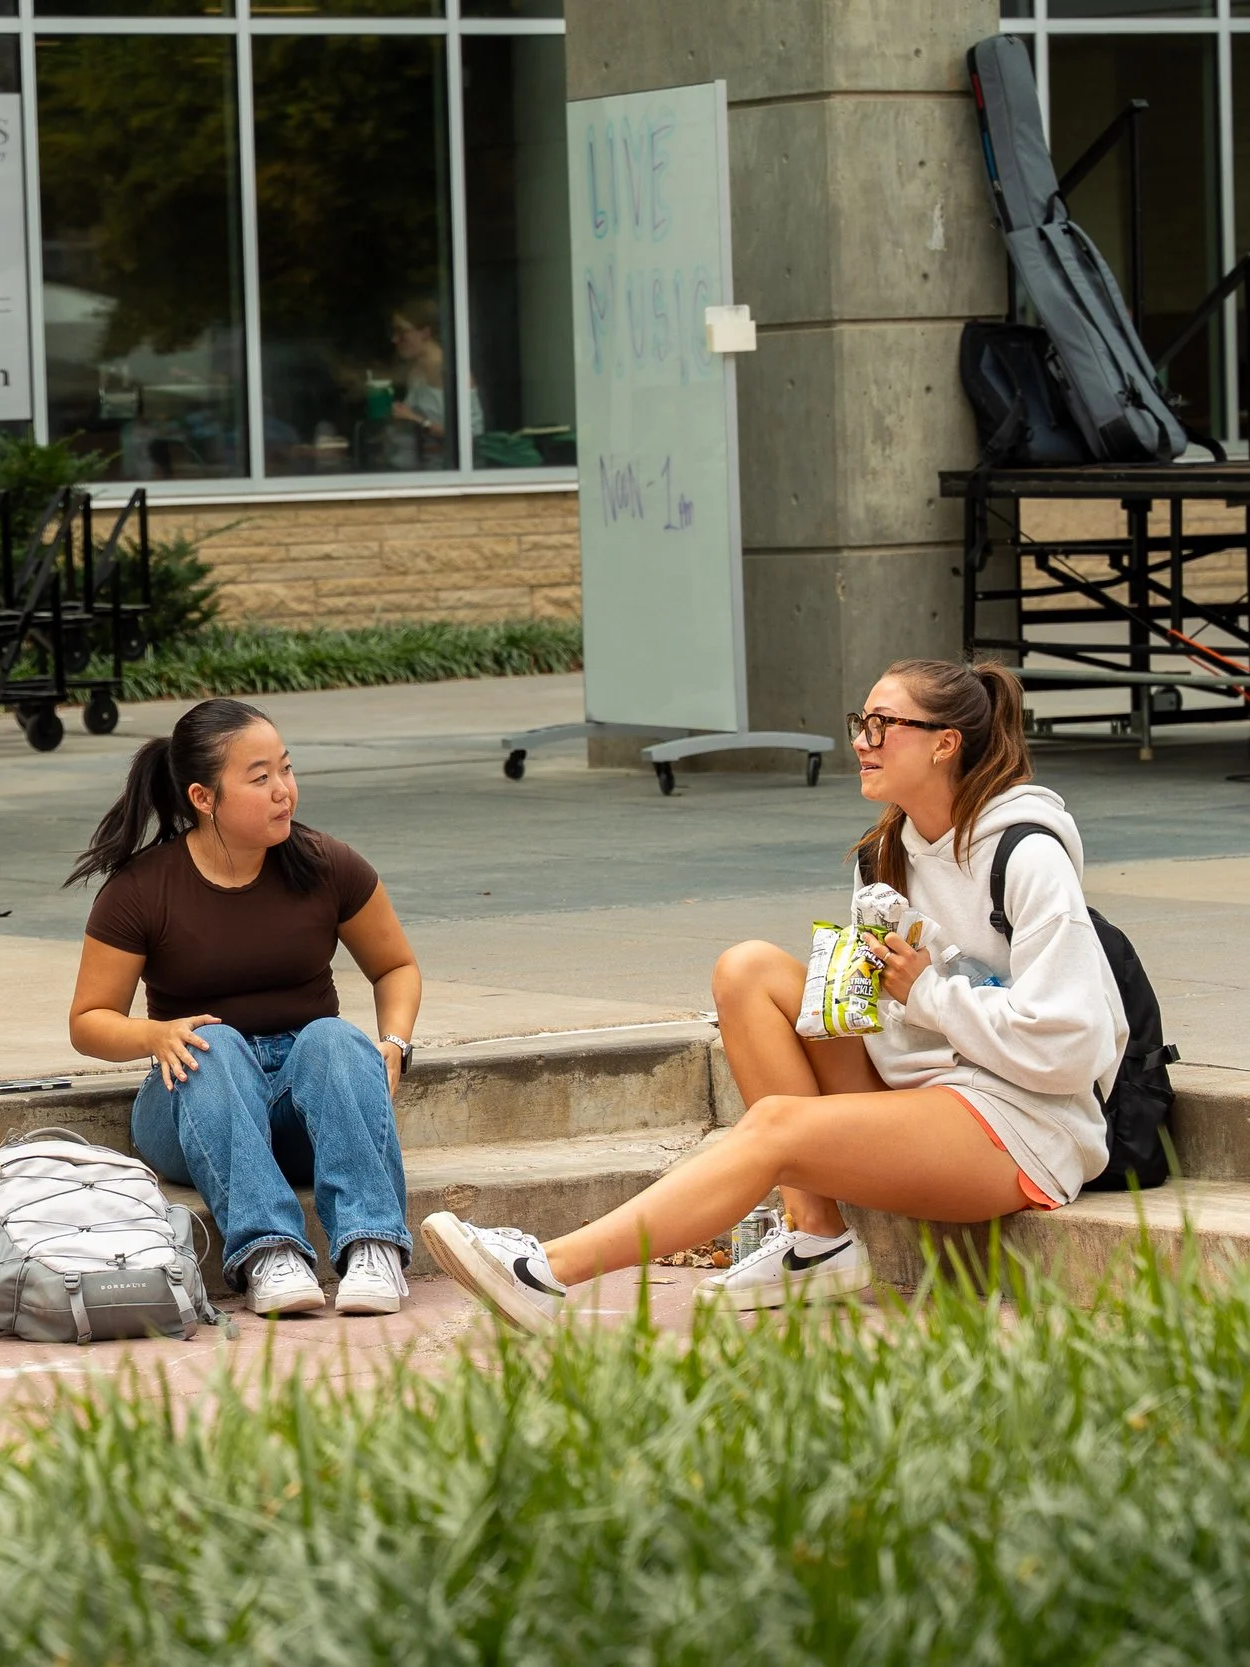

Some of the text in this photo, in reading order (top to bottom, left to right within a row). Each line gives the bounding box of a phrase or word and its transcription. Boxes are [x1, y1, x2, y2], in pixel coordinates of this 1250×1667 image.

[586, 107, 676, 240] LIVE
[845, 983, 873, 997] PICKLE
[100, 1282, 147, 1290] BOREALIS
